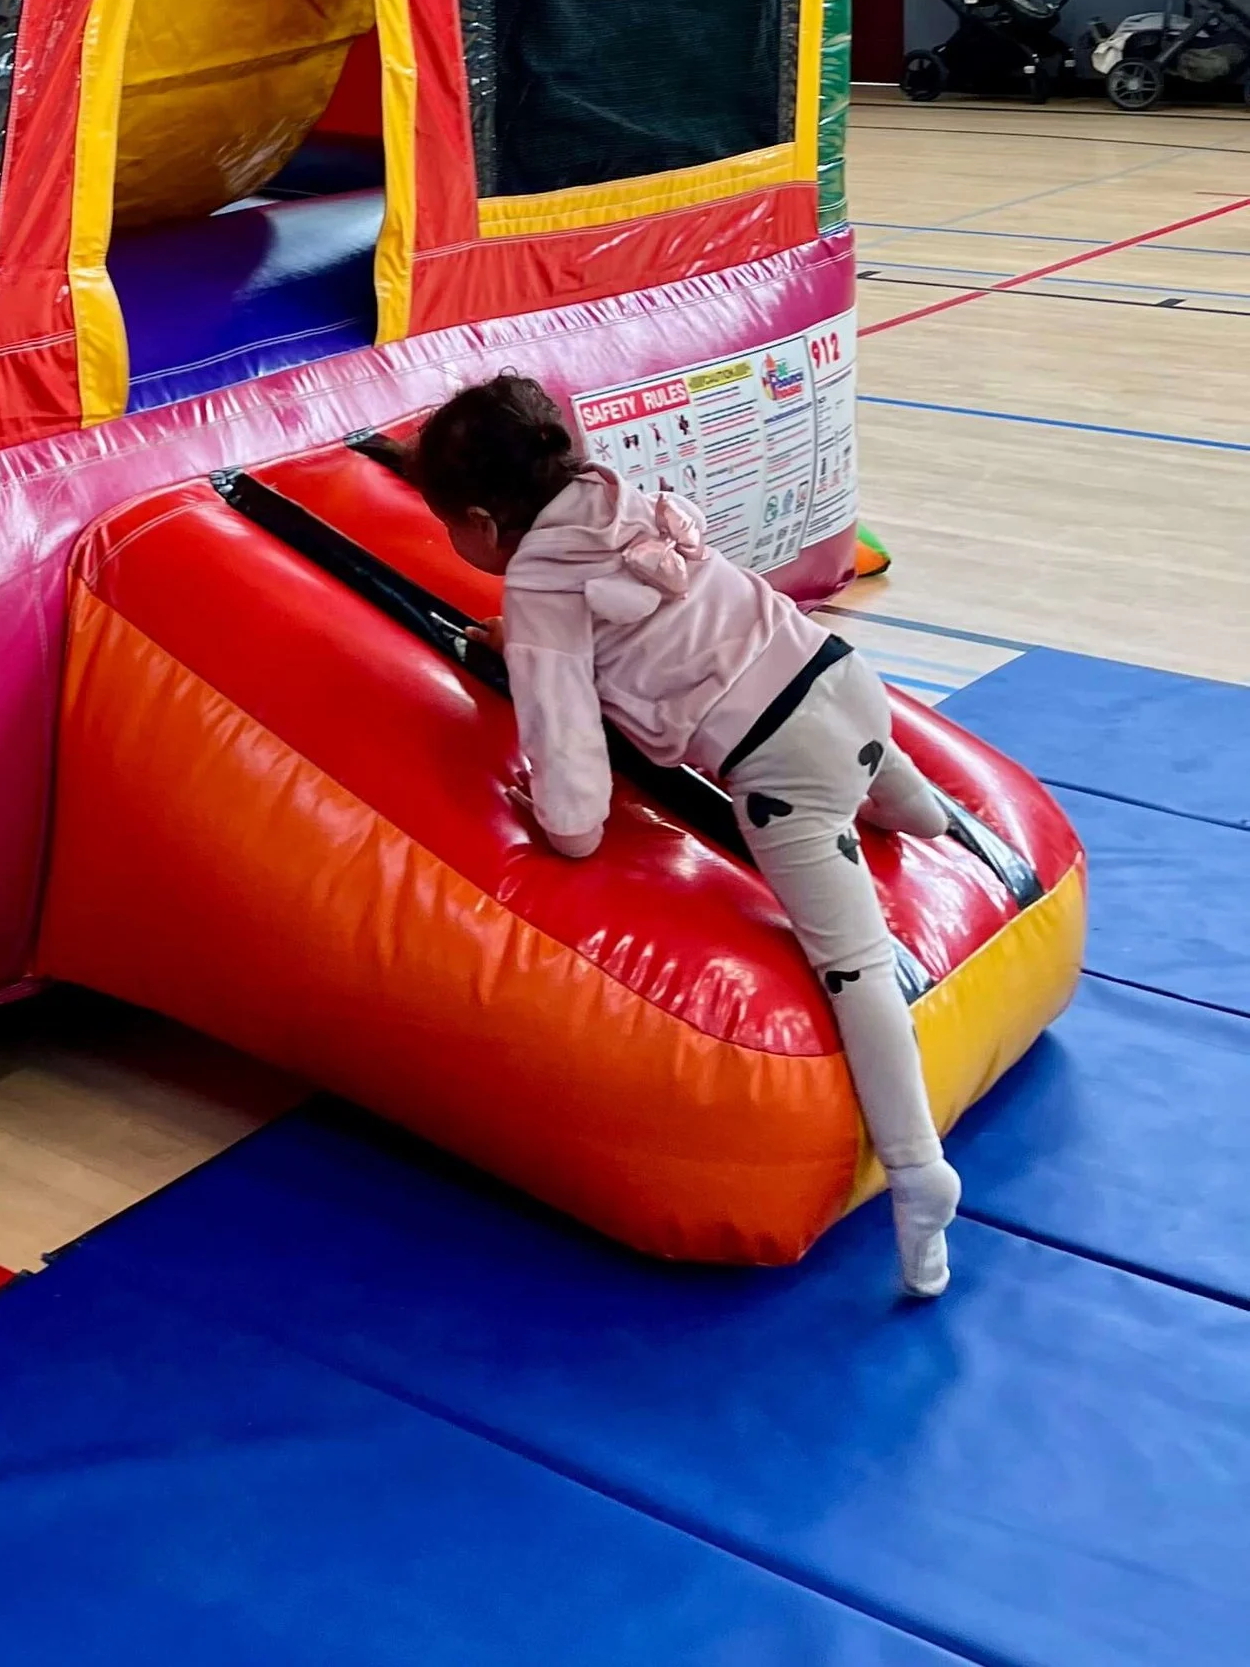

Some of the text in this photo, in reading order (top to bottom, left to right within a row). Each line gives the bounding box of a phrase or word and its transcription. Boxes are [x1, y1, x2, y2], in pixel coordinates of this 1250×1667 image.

[811, 332, 840, 369] 912
[582, 396, 637, 426] SAFETY
[642, 383, 686, 411] RULES
